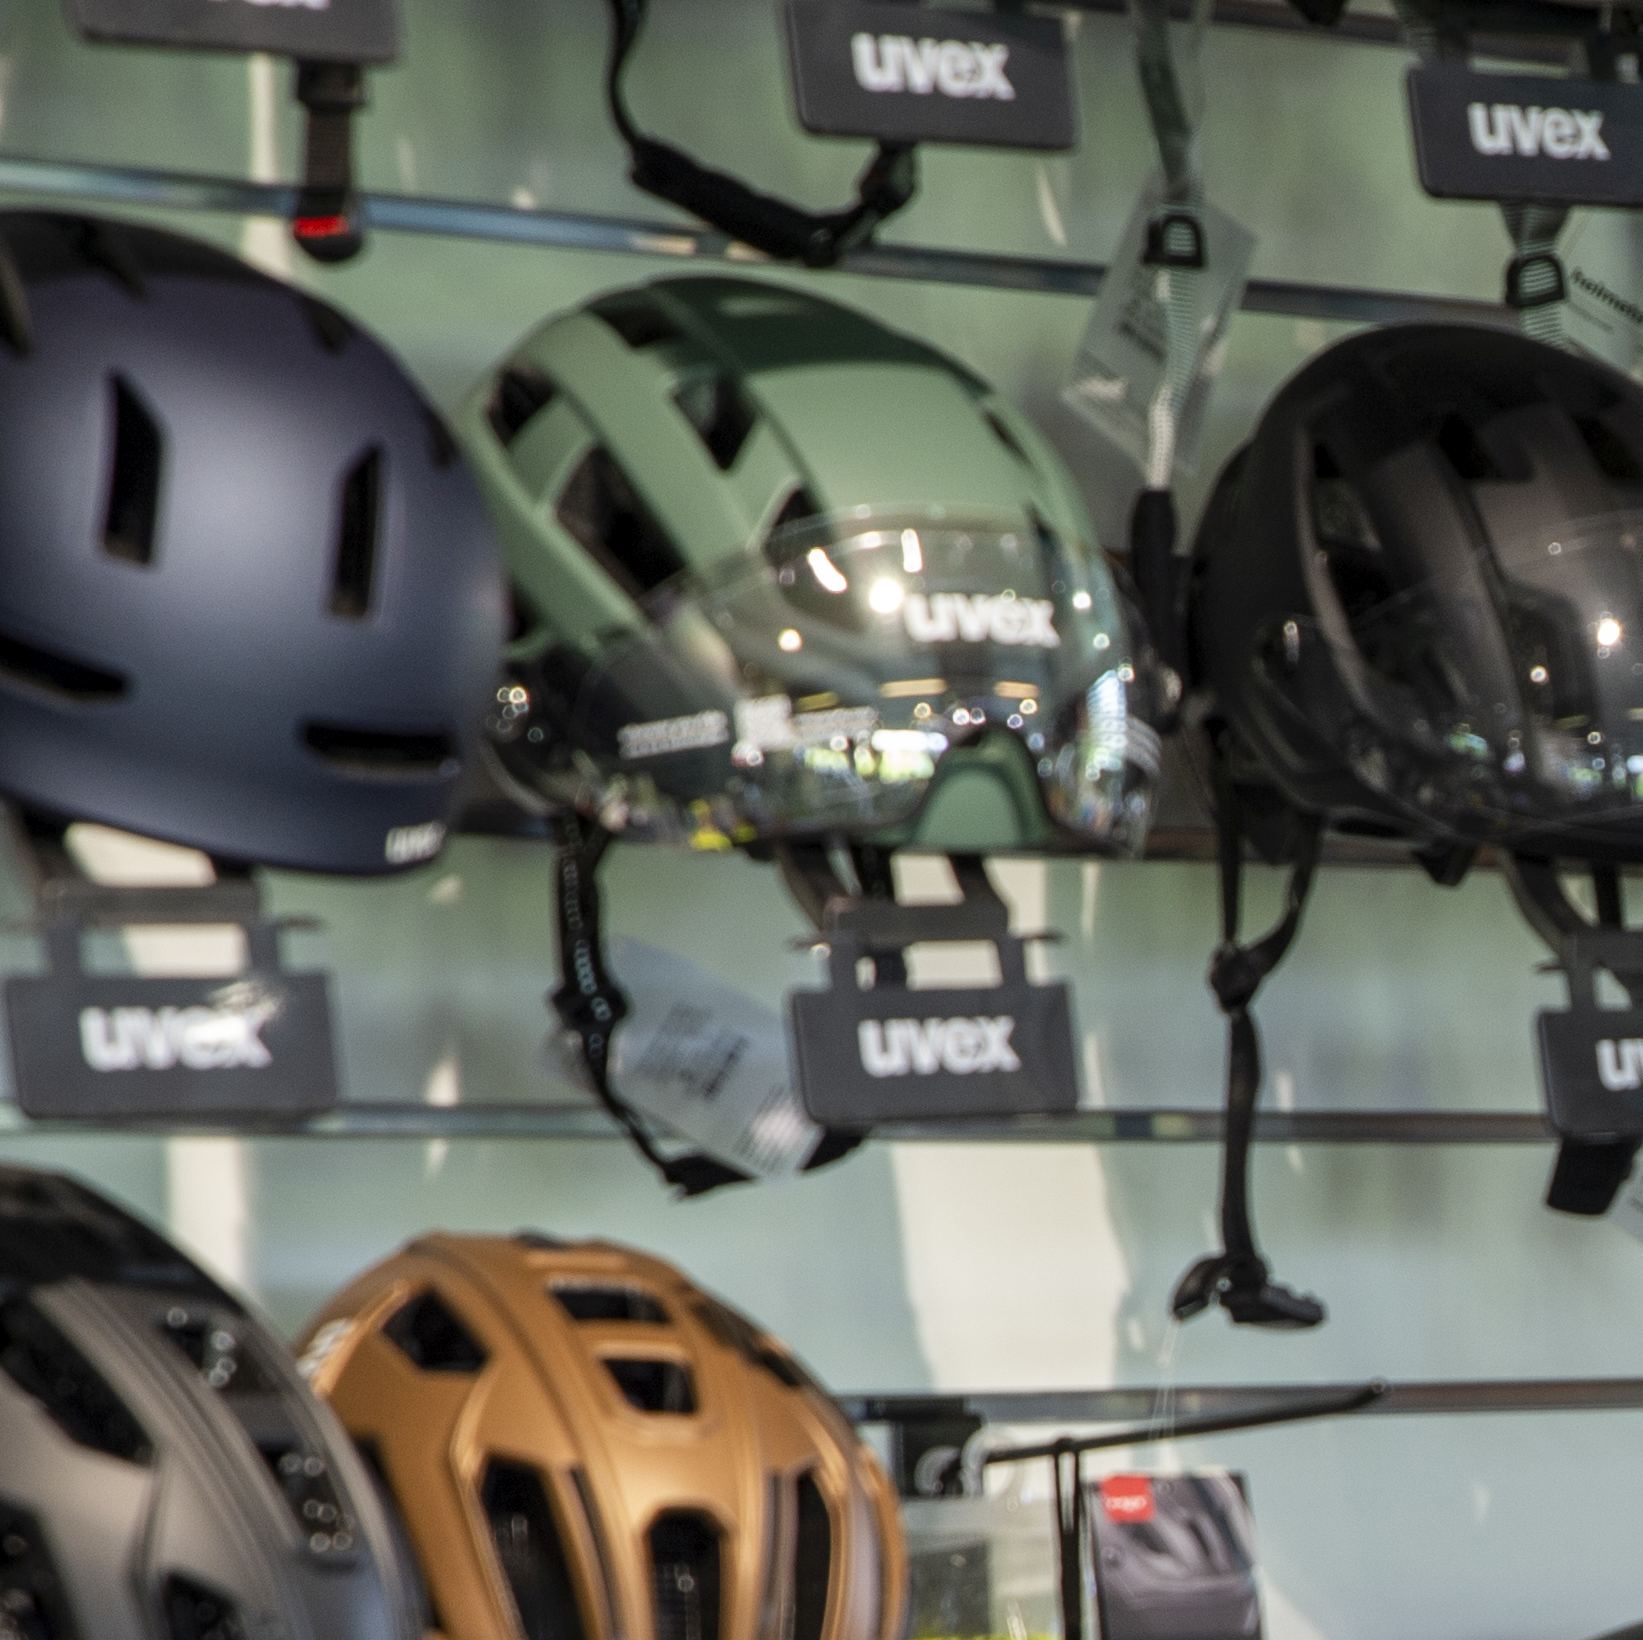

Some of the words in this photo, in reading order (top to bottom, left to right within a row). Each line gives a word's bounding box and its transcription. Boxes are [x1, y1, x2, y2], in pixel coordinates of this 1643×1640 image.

[853, 33, 1015, 101] uvex
[1468, 100, 1609, 160] uvex
[904, 592, 1060, 649] uvex
[80, 1005, 272, 1070] uvex
[860, 1012, 1019, 1074] uvex
